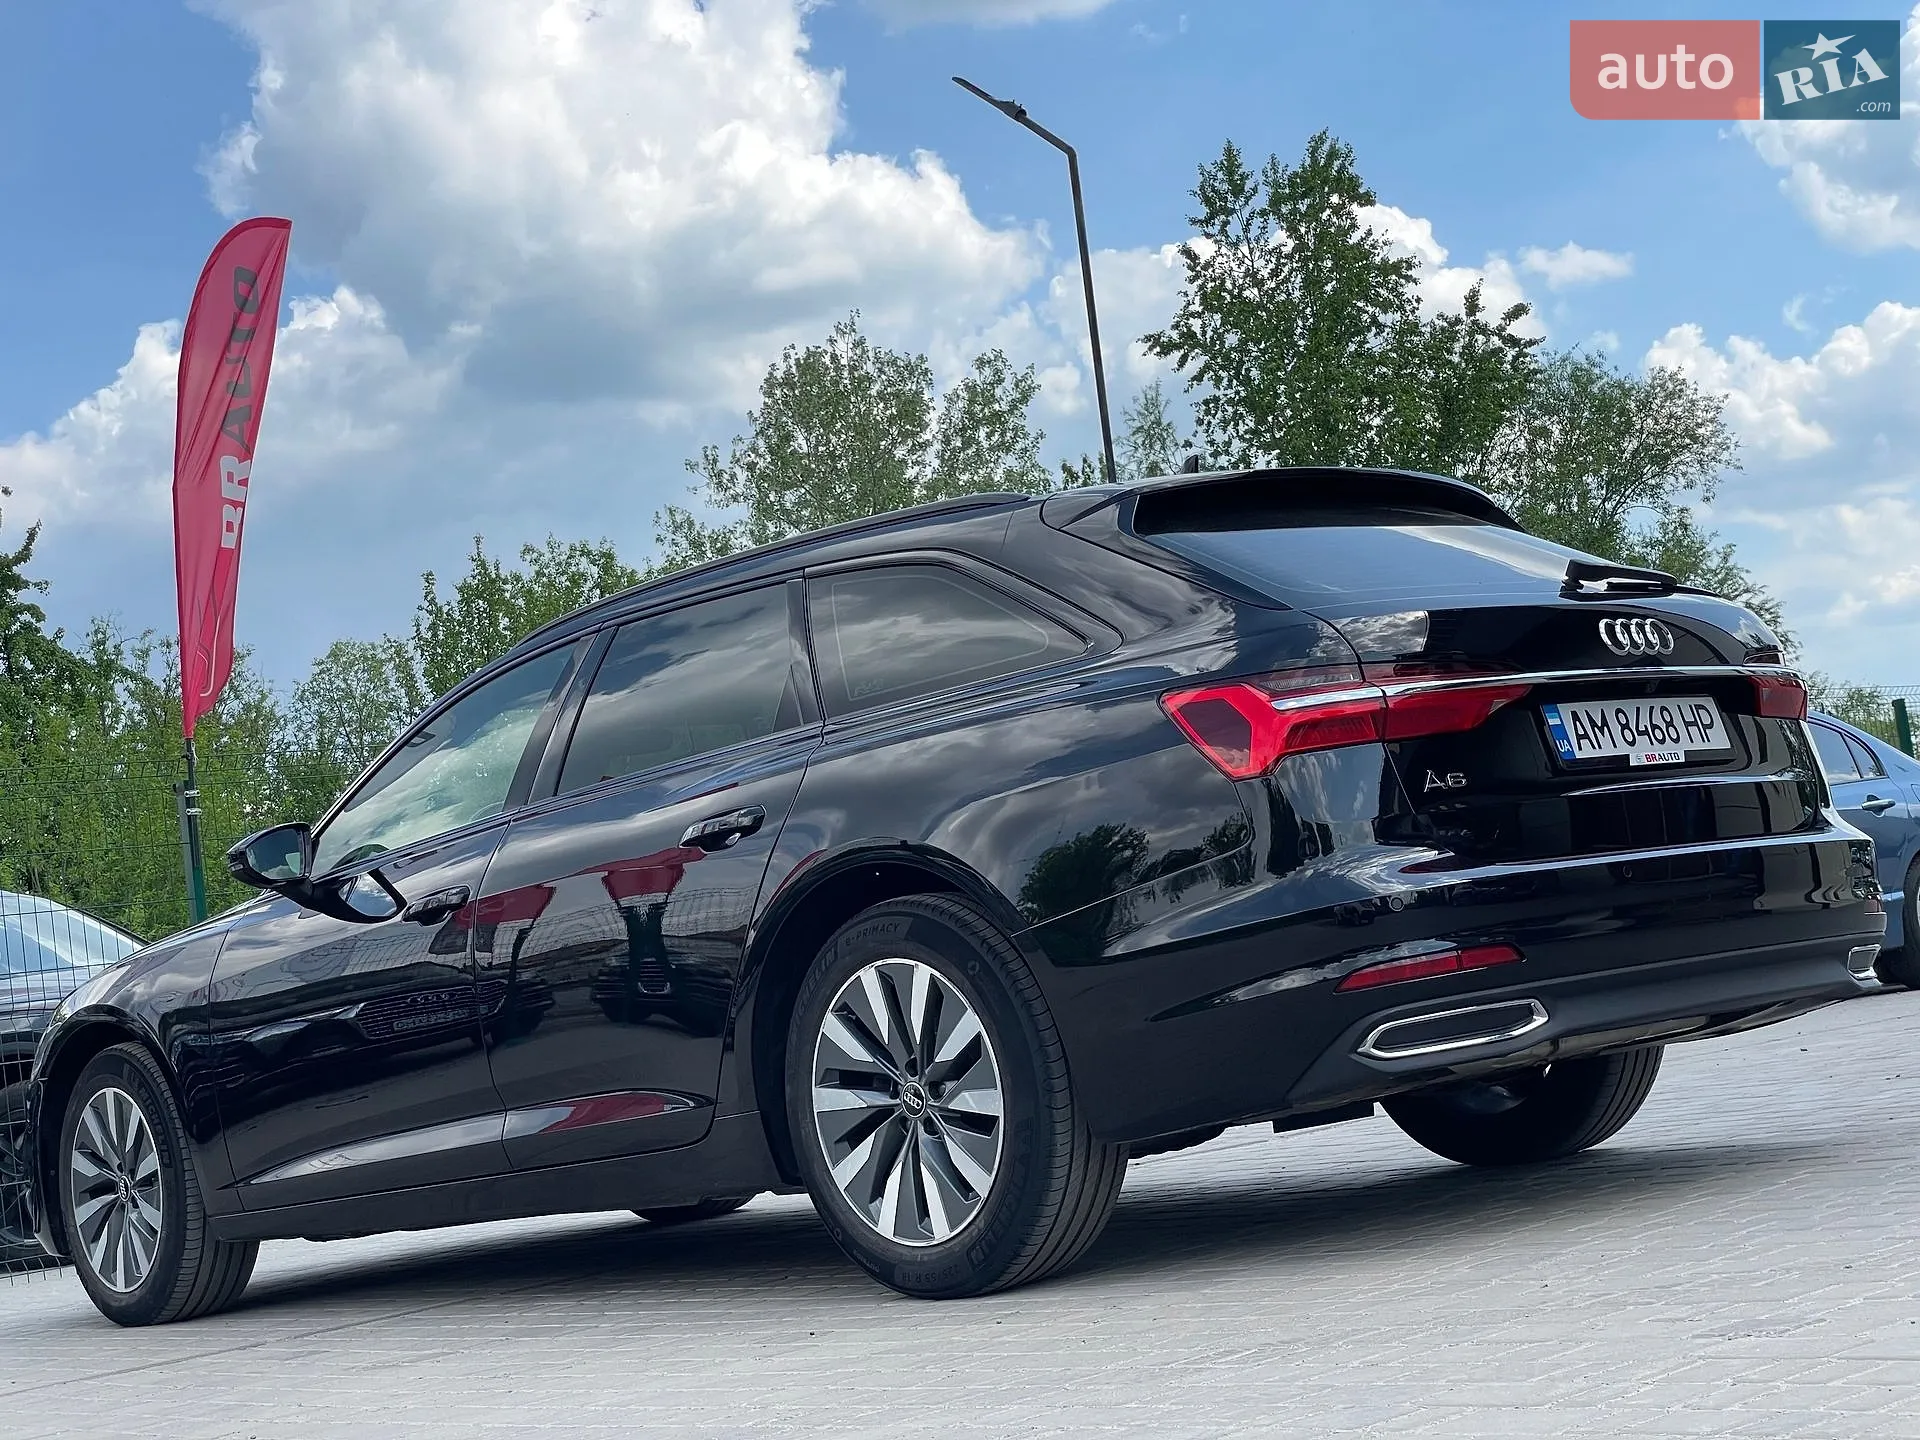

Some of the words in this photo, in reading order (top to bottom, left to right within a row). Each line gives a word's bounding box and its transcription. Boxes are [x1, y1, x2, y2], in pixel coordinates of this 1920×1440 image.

[220, 265, 260, 549] BRAUTO
[1570, 708, 1617, 751] AM
[1615, 705, 1681, 747] 8468
[1677, 703, 1714, 744] HP
[1556, 740, 1572, 752] UA
[1644, 752, 1680, 763] BRAUTO
[1423, 769, 1467, 793] A6
